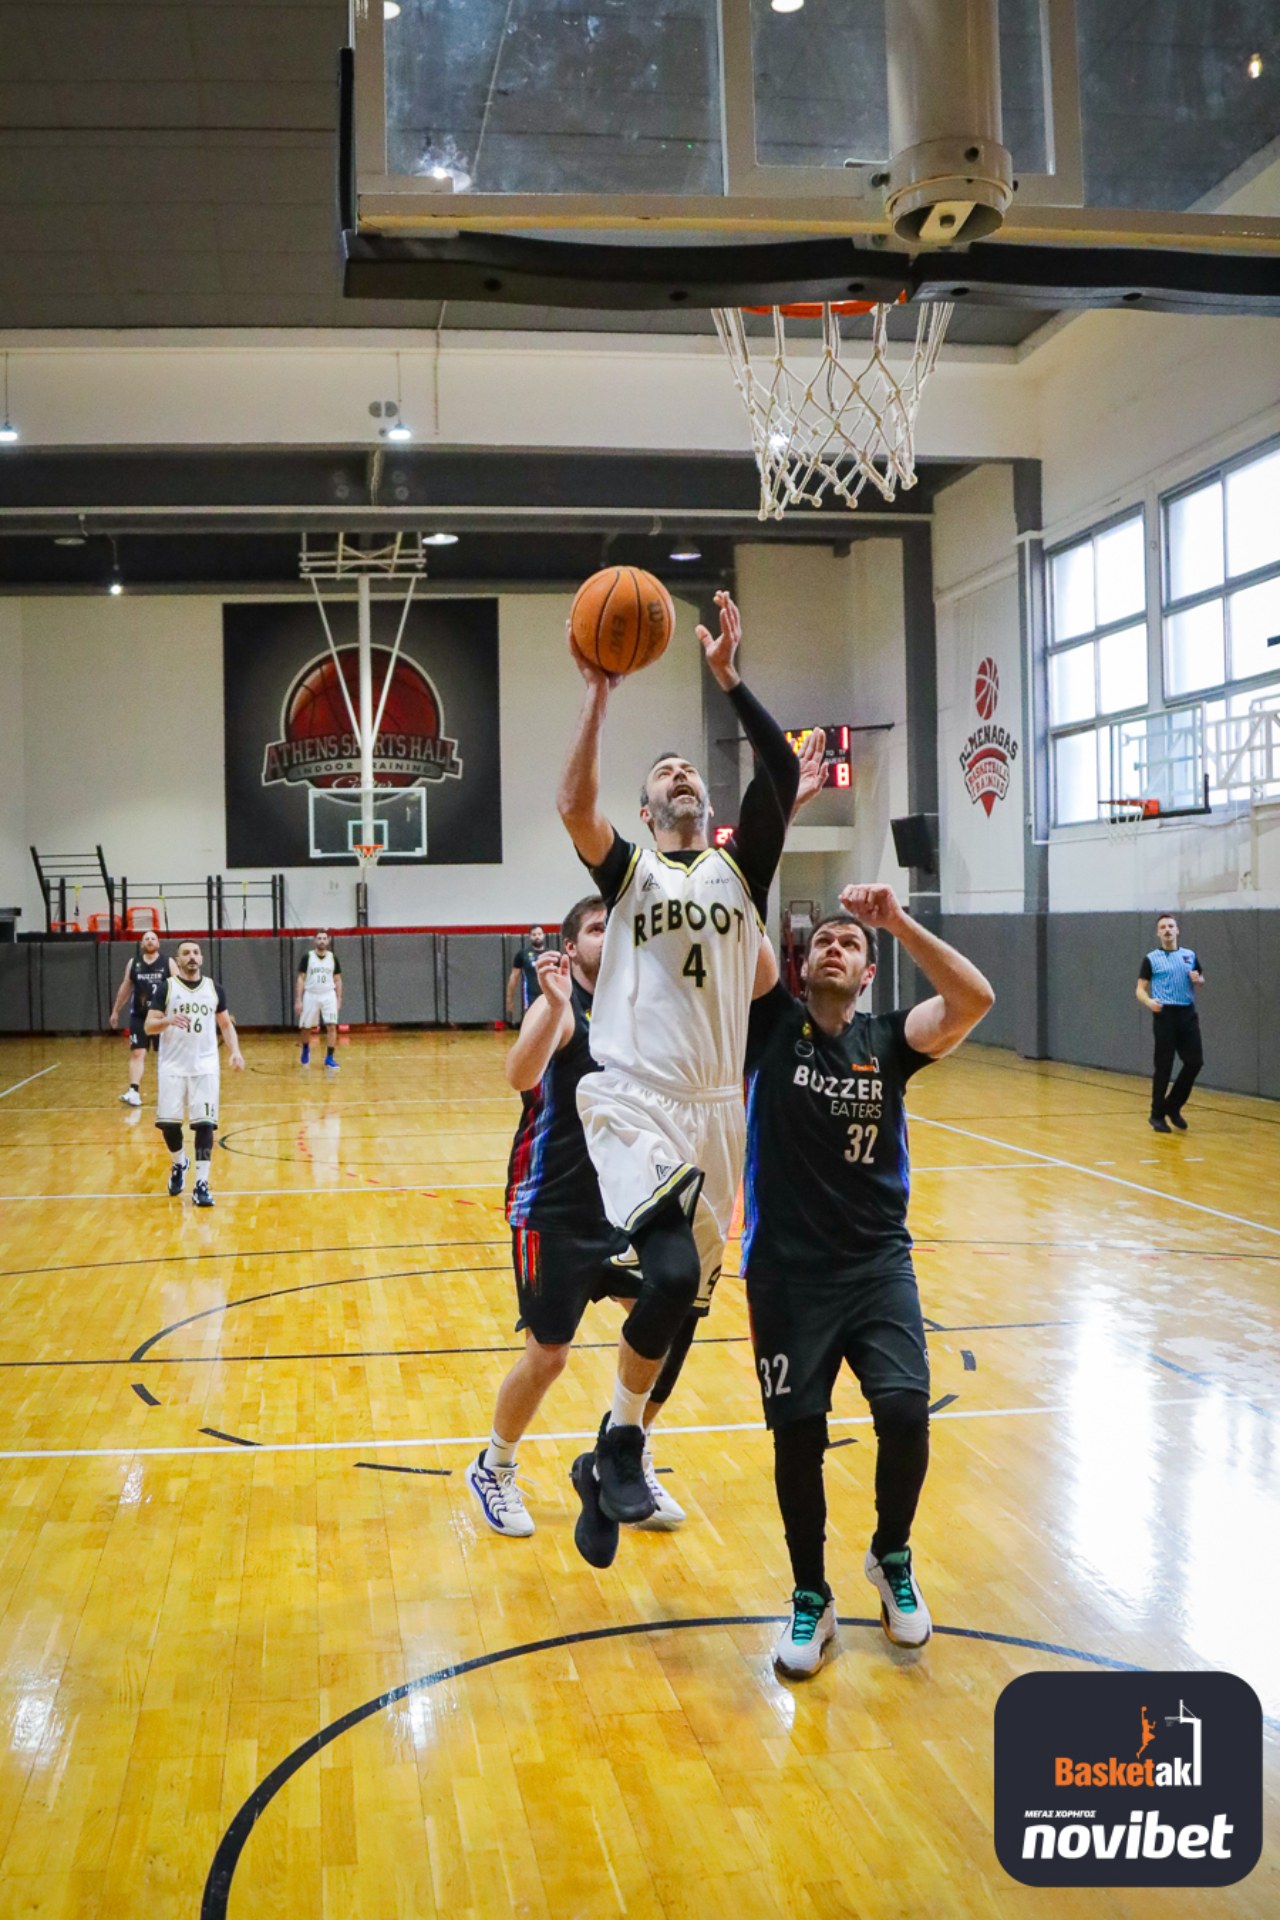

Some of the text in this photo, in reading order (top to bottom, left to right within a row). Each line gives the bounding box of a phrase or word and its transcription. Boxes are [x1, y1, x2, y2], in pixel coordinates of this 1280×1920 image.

[266, 733, 460, 780] ATHENS SPRTS HALL
[296, 762, 434, 776] INDOOR RAINING
[633, 899, 745, 947] REBOOT
[683, 943, 707, 987] 4
[793, 1064, 883, 1101] BUZZER
[831, 1100, 883, 1119] EATERS
[844, 1123, 879, 1164] 32
[760, 1353, 792, 1398] 32
